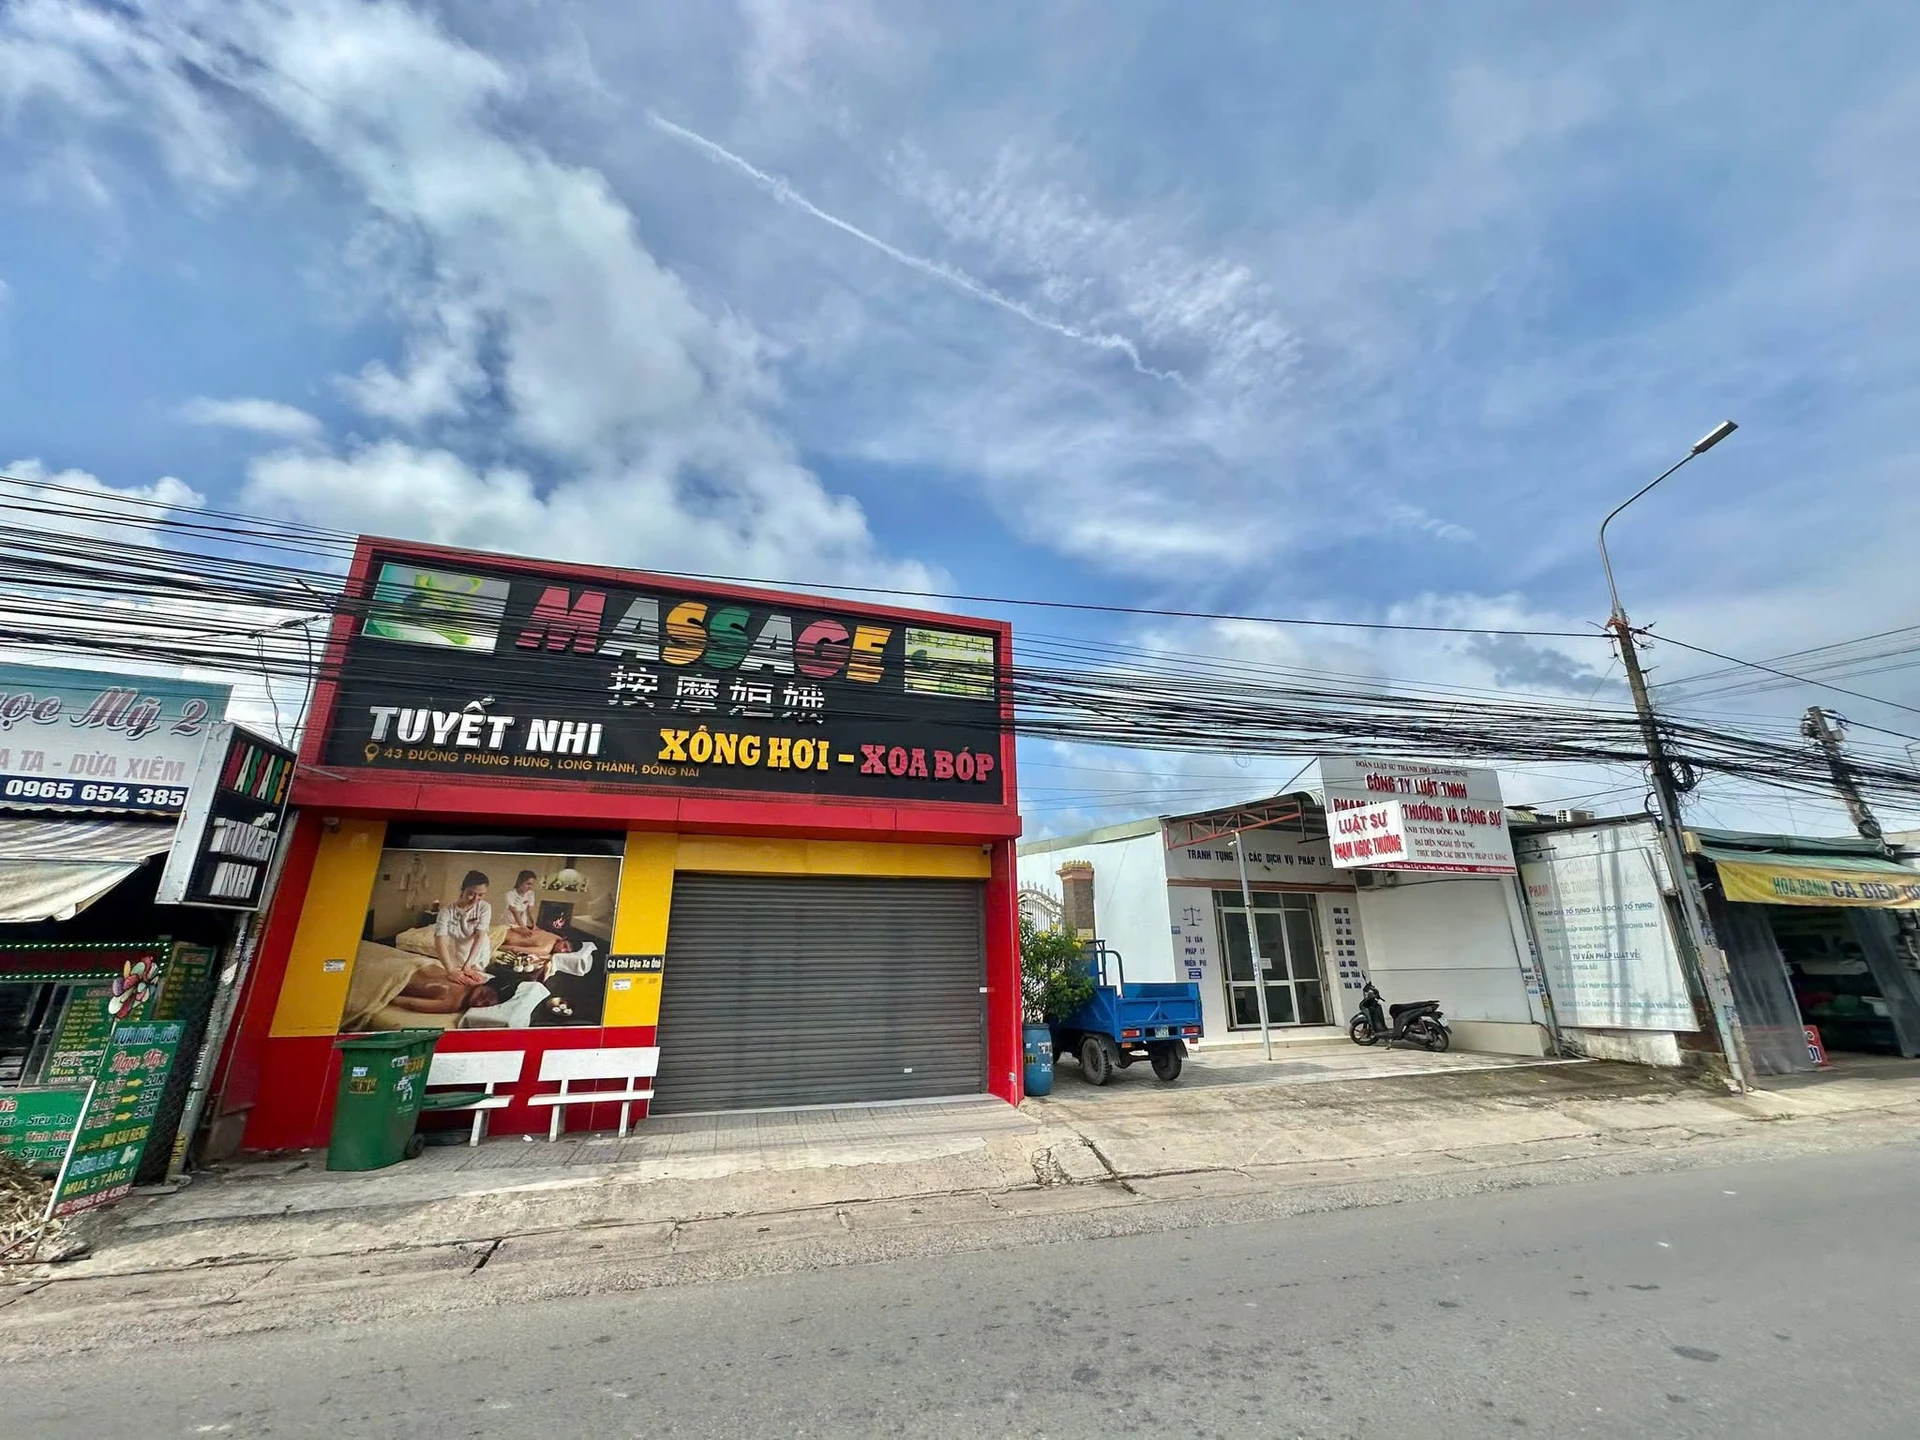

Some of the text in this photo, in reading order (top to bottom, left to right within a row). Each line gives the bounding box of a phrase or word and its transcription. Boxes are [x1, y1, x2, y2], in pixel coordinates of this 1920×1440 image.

[515, 586, 892, 684] MASSAGE
[0, 686, 208, 740] ọc Mỹ 2
[369, 694, 603, 756] TUYẾT NHI
[20, 750, 44, 773] TA
[68, 750, 117, 776] DỪA
[124, 755, 185, 783] XIÊM
[384, 748, 403, 758] 43
[464, 751, 510, 766] PHÙNG
[558, 759, 593, 771] LONG
[596, 760, 638, 775] THÀNH,
[681, 767, 699, 777] NAI
[658, 725, 761, 767] XÔNG
[767, 736, 830, 771] HƠI
[860, 743, 928, 779] XOA
[934, 746, 994, 782] BÓP
[221, 740, 292, 804] MASSAGE
[1365, 772, 1468, 798] CÔNG TY LUẬT TNHH
[5, 779, 186, 807] 0965 654 385
[1338, 810, 1388, 834] LUẬT SƯ
[1460, 806, 1487, 827] CỘNG
[1187, 849, 1211, 860] TRANH
[1215, 850, 1234, 863] TỤNG
[1266, 853, 1281, 865] DỊCH
[1334, 842, 1354, 862] PHẠM
[209, 861, 258, 899] NHI
[46, 1144, 66, 1158] Riê
[90, 1177, 98, 1188] 5
